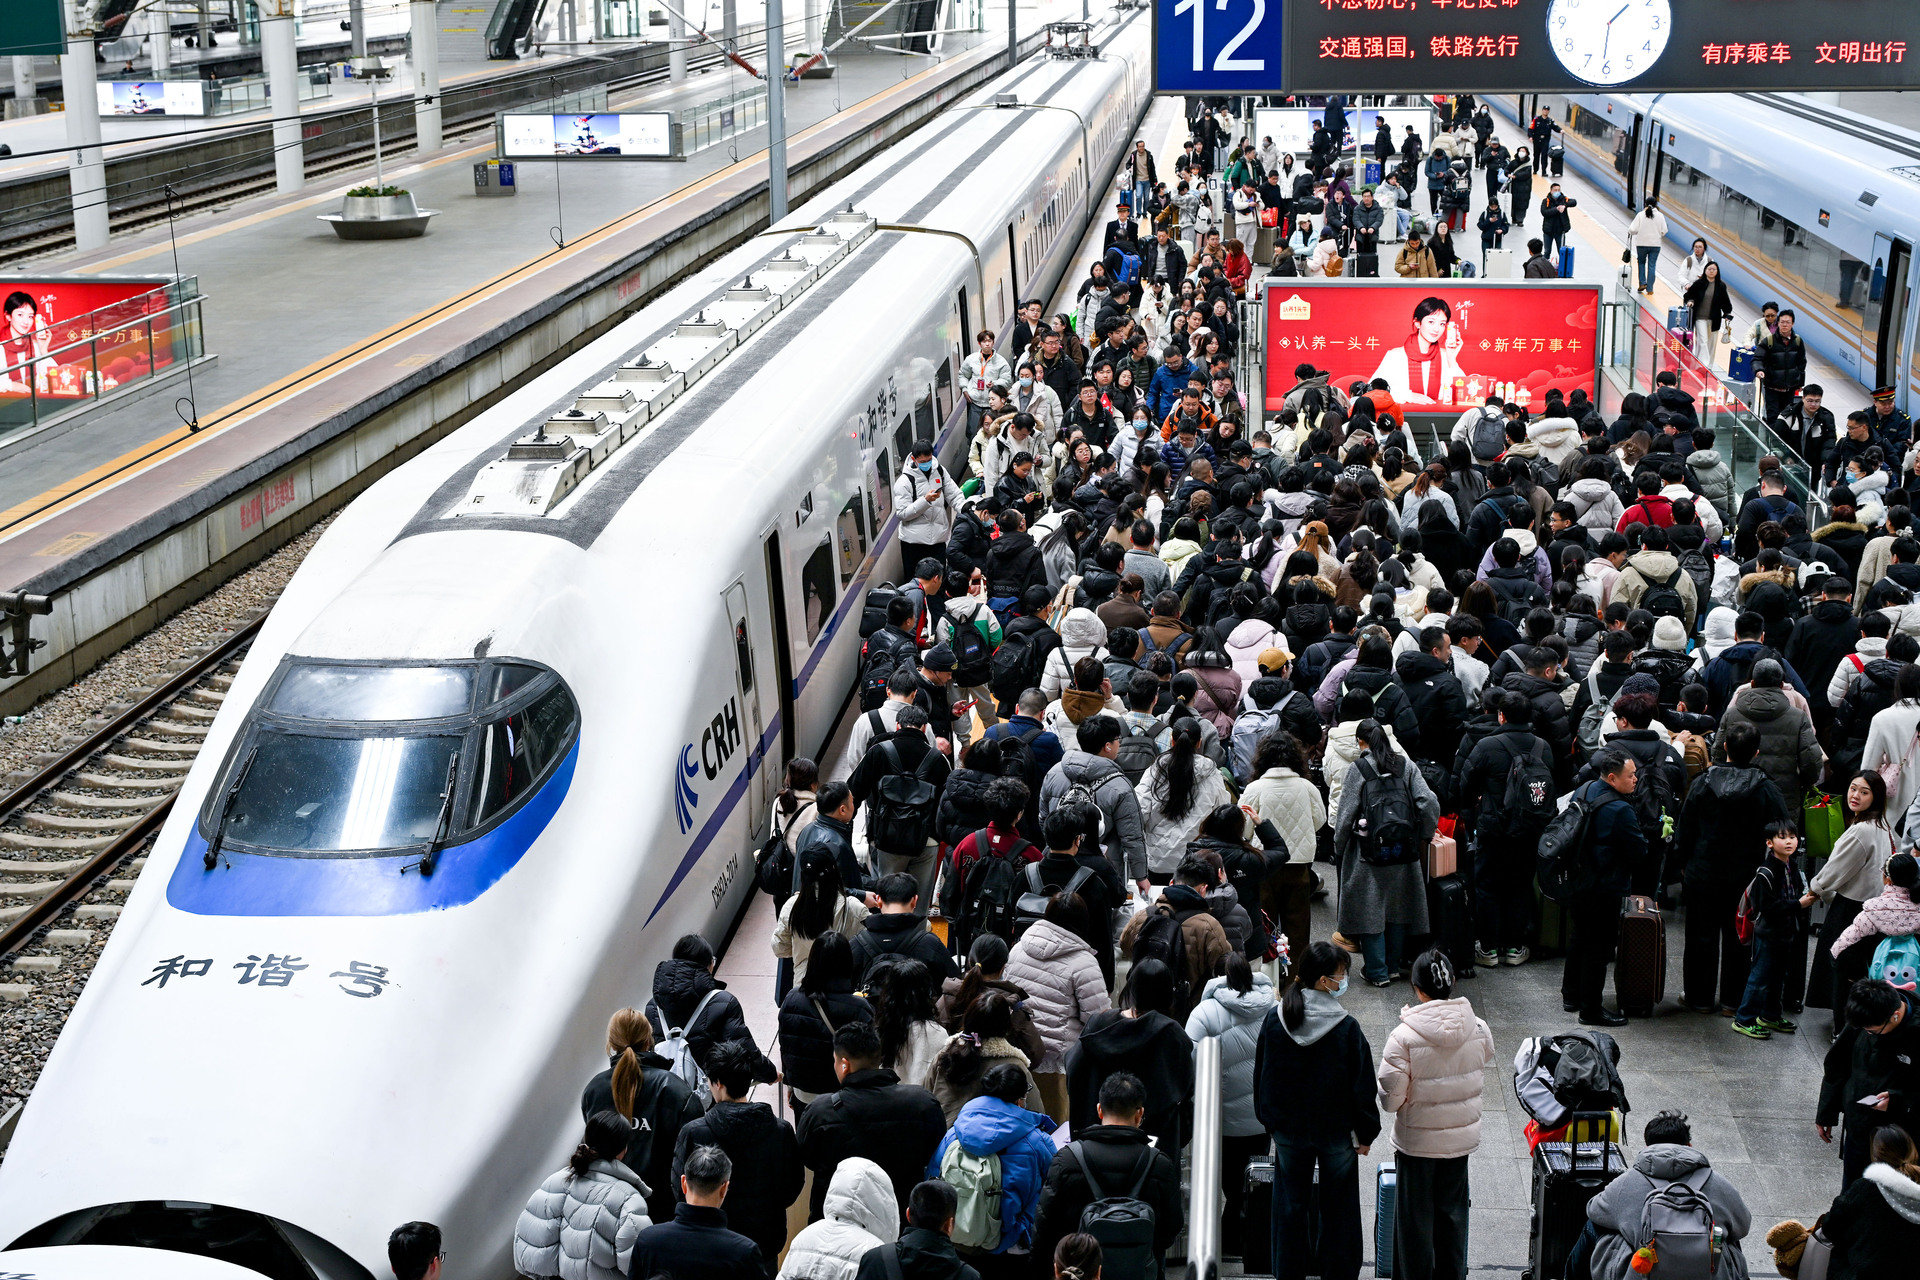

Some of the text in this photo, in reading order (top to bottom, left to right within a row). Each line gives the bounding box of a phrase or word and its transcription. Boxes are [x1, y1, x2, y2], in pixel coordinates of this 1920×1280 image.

[1558, 15, 1567, 30] 9
[1651, 15, 1661, 31] 3
[1174, 0, 1266, 72] 12
[1319, 35, 1520, 59] 交通强国，铁路先行
[1564, 37, 1574, 53] 8
[1641, 39, 1652, 54] 4
[1701, 40, 1907, 65] 有序乘车 文明出行
[1583, 53, 1593, 69] 7
[1601, 60, 1611, 75] 6
[1624, 54, 1634, 70] 5
[1294, 335, 1381, 351] 认养一头牛
[1494, 337, 1582, 353] 新年万事牛
[866, 375, 898, 448] 和谐号
[701, 696, 742, 781] CRH
[140, 953, 392, 999] 和谐号
